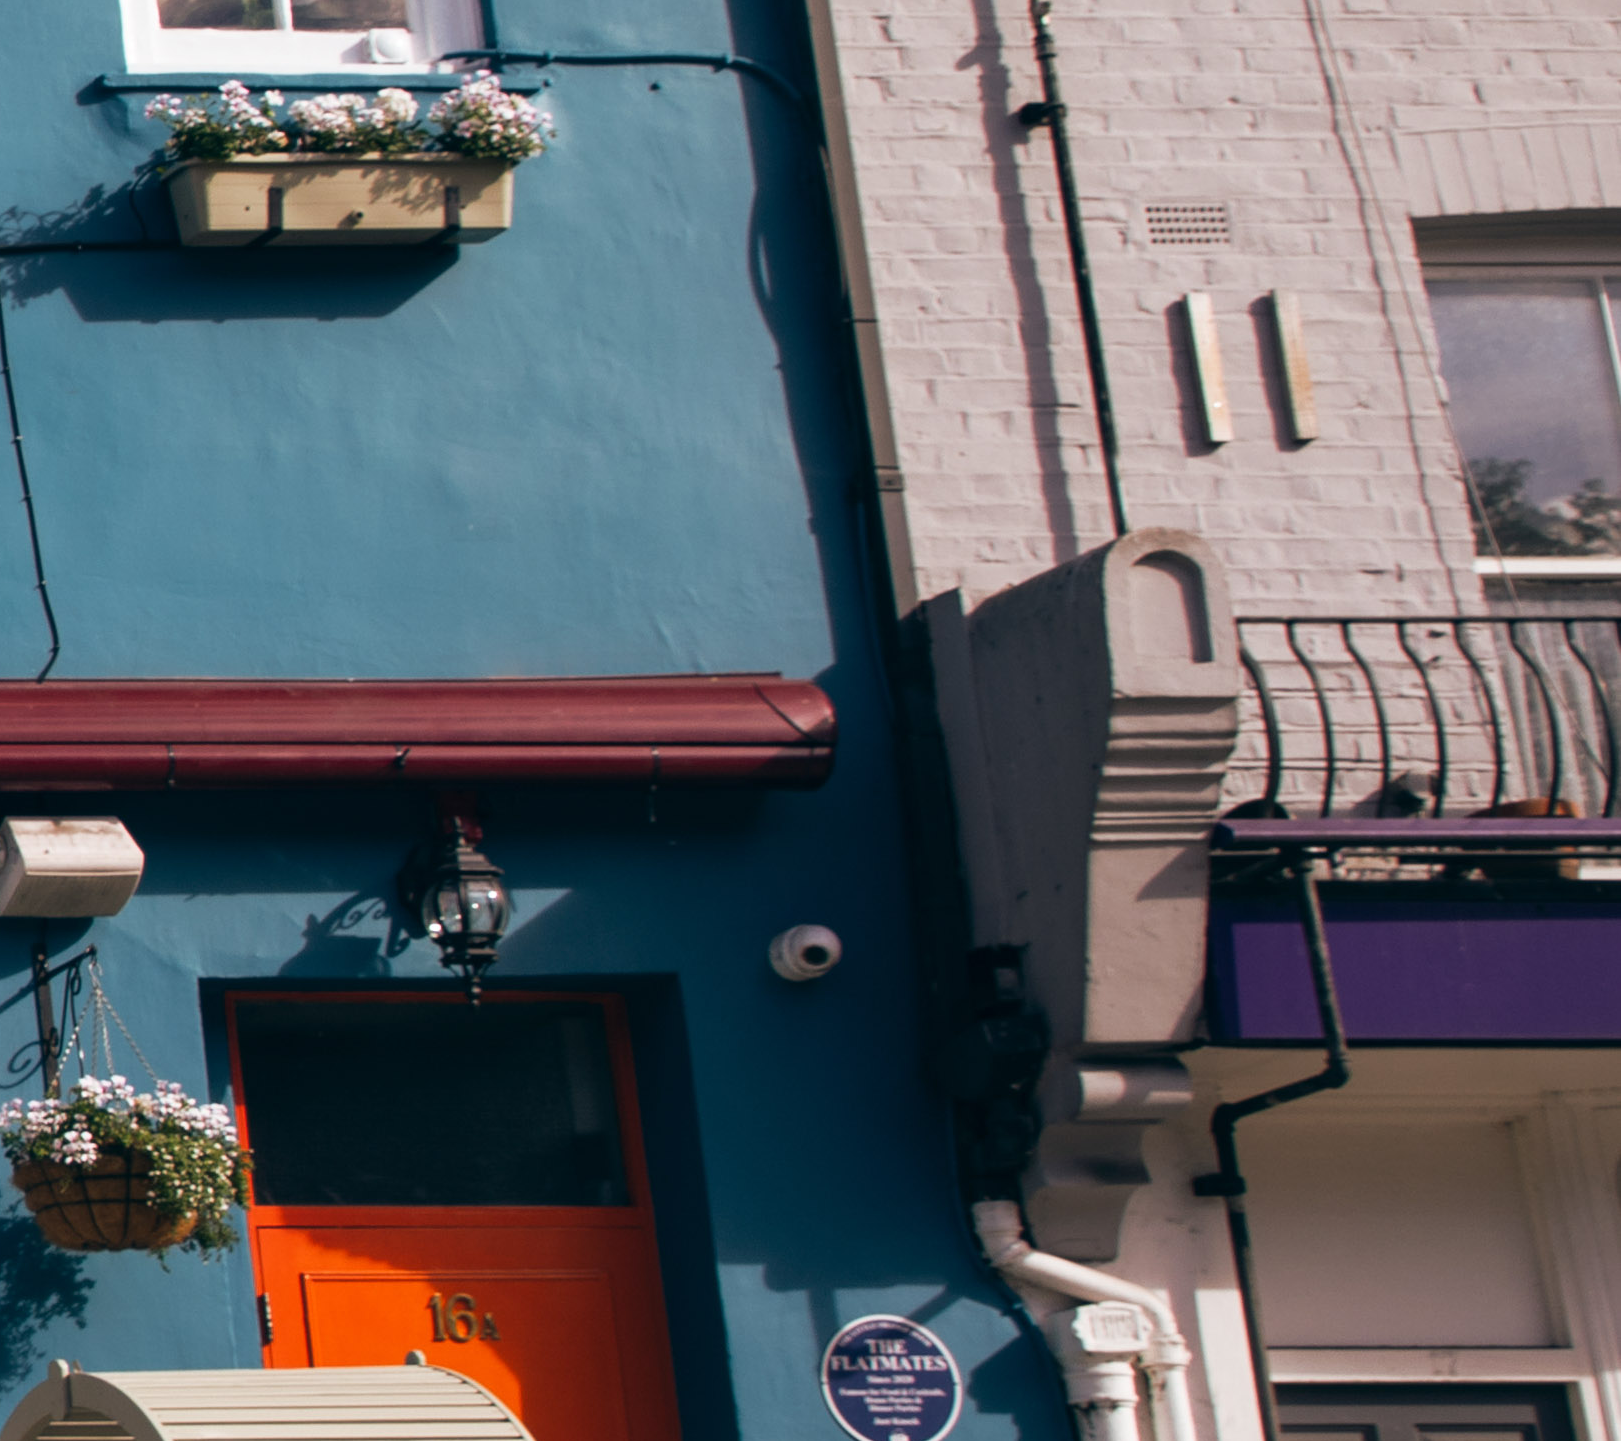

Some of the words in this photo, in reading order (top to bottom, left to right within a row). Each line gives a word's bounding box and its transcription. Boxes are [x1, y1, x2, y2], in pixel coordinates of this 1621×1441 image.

[426, 1292, 501, 1343] 16A
[864, 1339, 907, 1354] THE
[831, 1356, 947, 1371] FLATMATES
